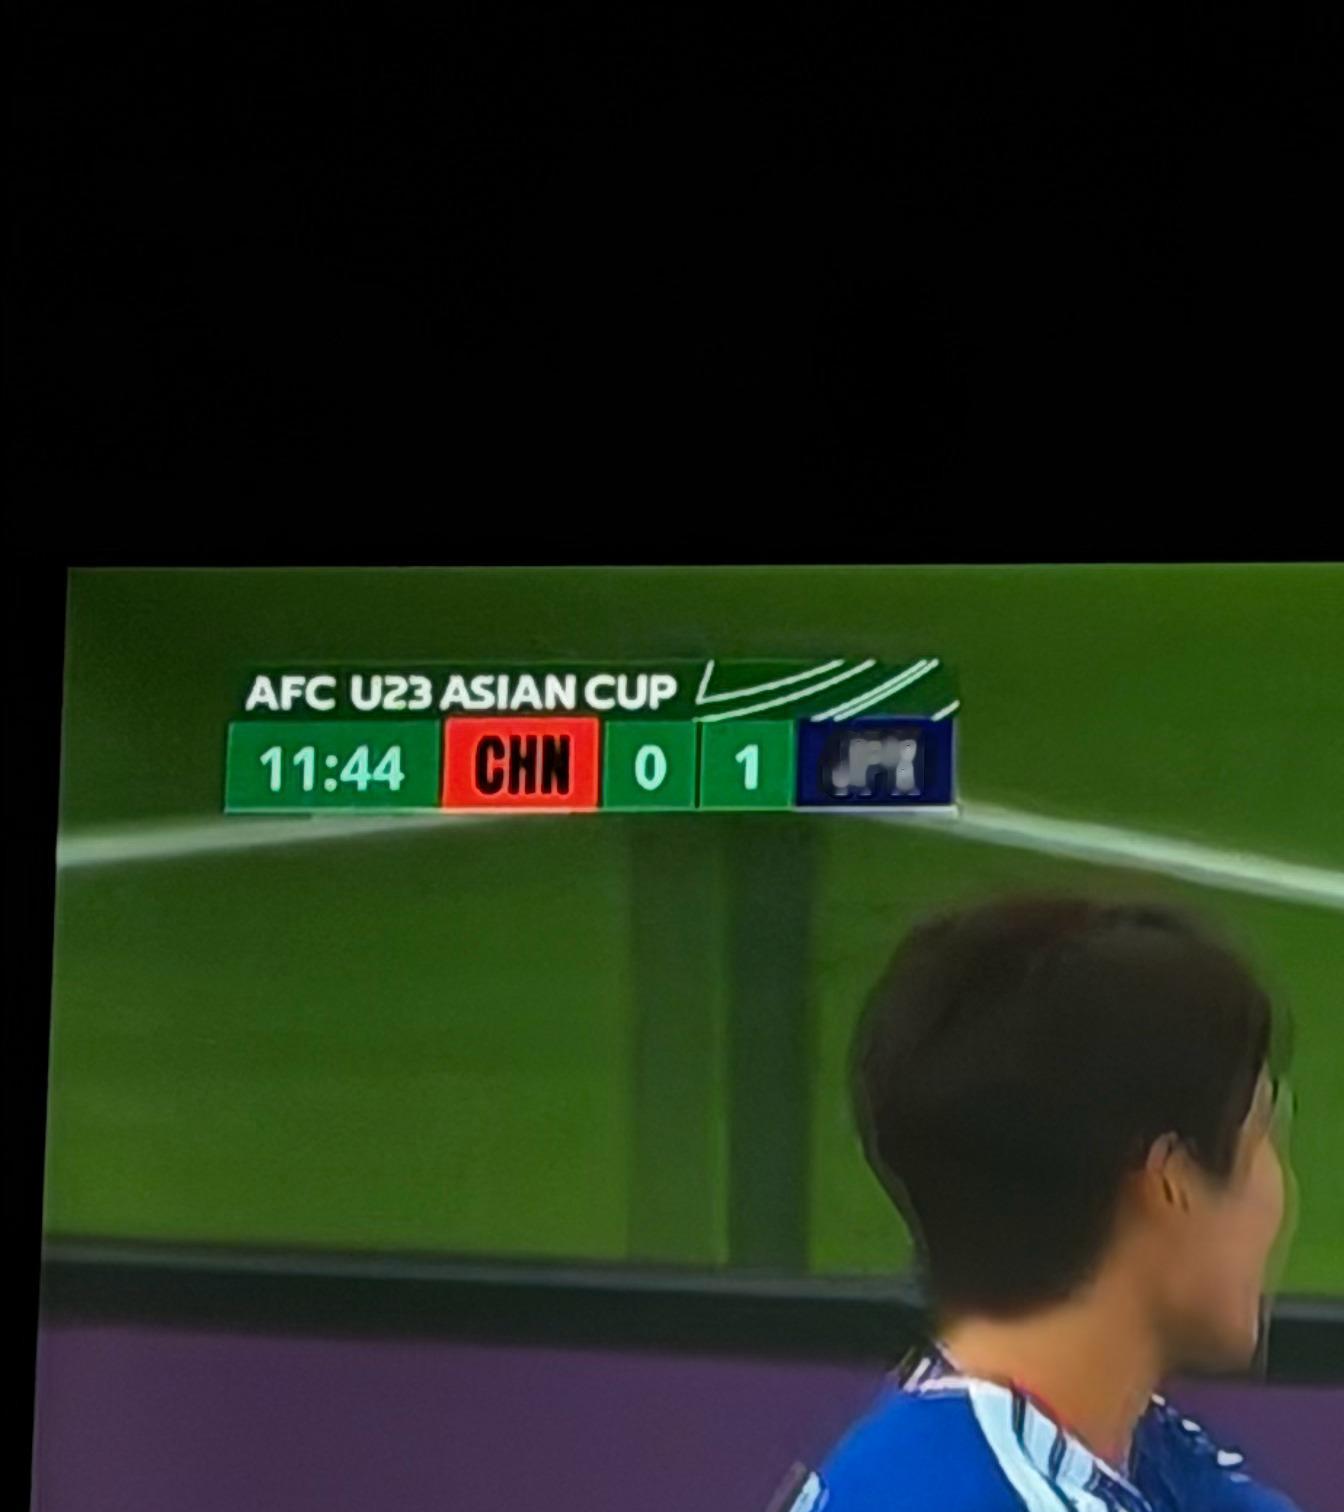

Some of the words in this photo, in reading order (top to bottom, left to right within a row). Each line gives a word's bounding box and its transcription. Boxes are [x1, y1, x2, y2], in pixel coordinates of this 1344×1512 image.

[245, 674, 336, 711] AFC
[351, 674, 433, 711] U23
[439, 674, 577, 711] ASIAN
[584, 673, 678, 711] CUP
[259, 745, 405, 792] 11:44
[475, 734, 571, 796] CHN
[635, 744, 667, 791] 0
[735, 743, 759, 791] 1
